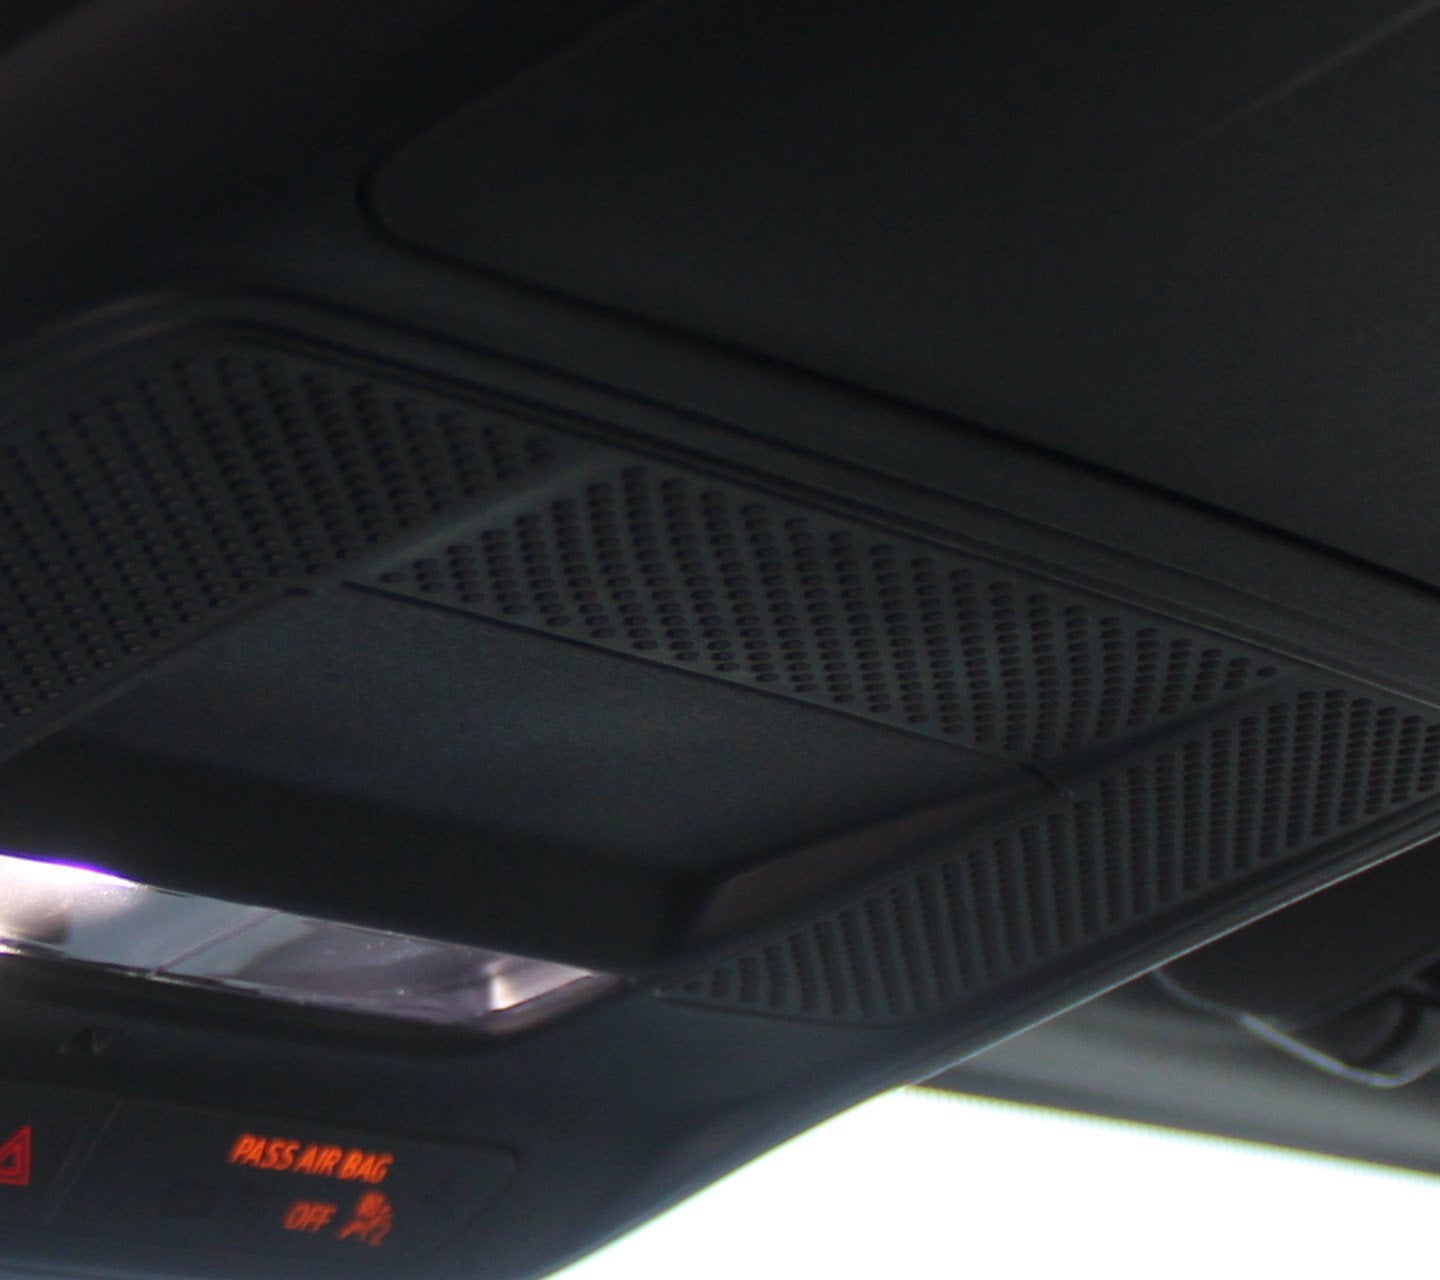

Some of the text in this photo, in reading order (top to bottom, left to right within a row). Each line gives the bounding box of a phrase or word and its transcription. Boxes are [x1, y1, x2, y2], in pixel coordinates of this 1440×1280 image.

[229, 1131, 395, 1185] PASS AIR BAG
[282, 1198, 339, 1233] OFF
